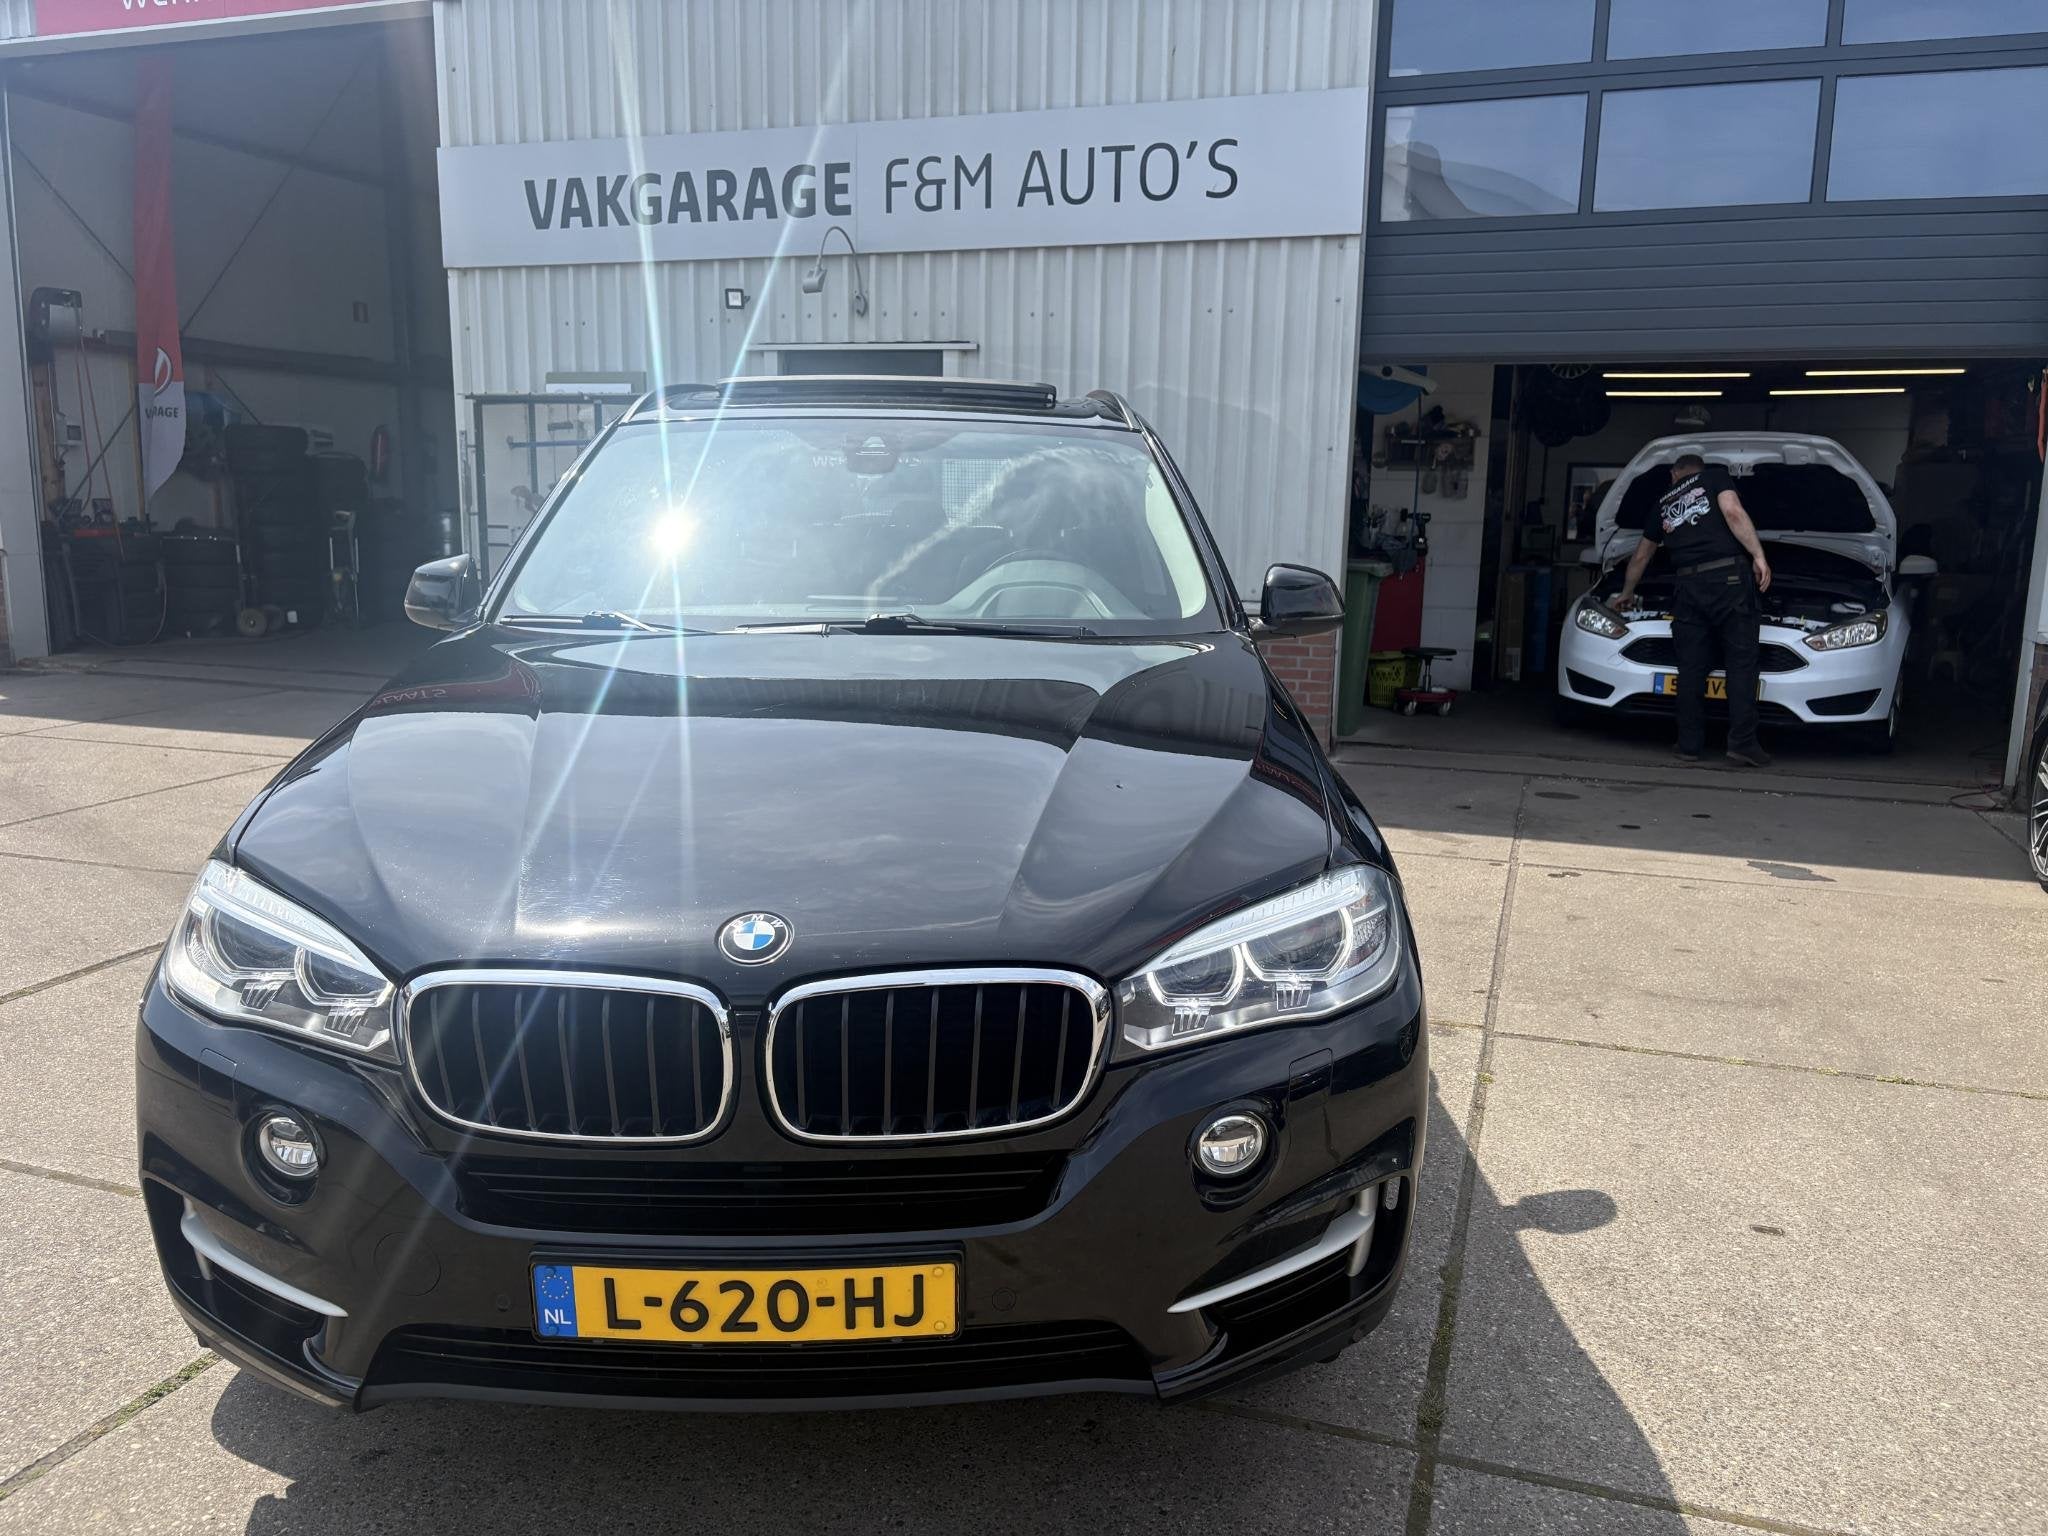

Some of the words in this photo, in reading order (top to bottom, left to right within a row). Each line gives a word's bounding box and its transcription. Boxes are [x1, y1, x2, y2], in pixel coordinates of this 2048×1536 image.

[524, 162, 852, 230] VAKGARAGE
[885, 153, 992, 214] F&M
[1017, 138, 1239, 207] AUTO'S
[544, 1308, 572, 1325] NL
[603, 1274, 925, 1333] L-620-HJ
